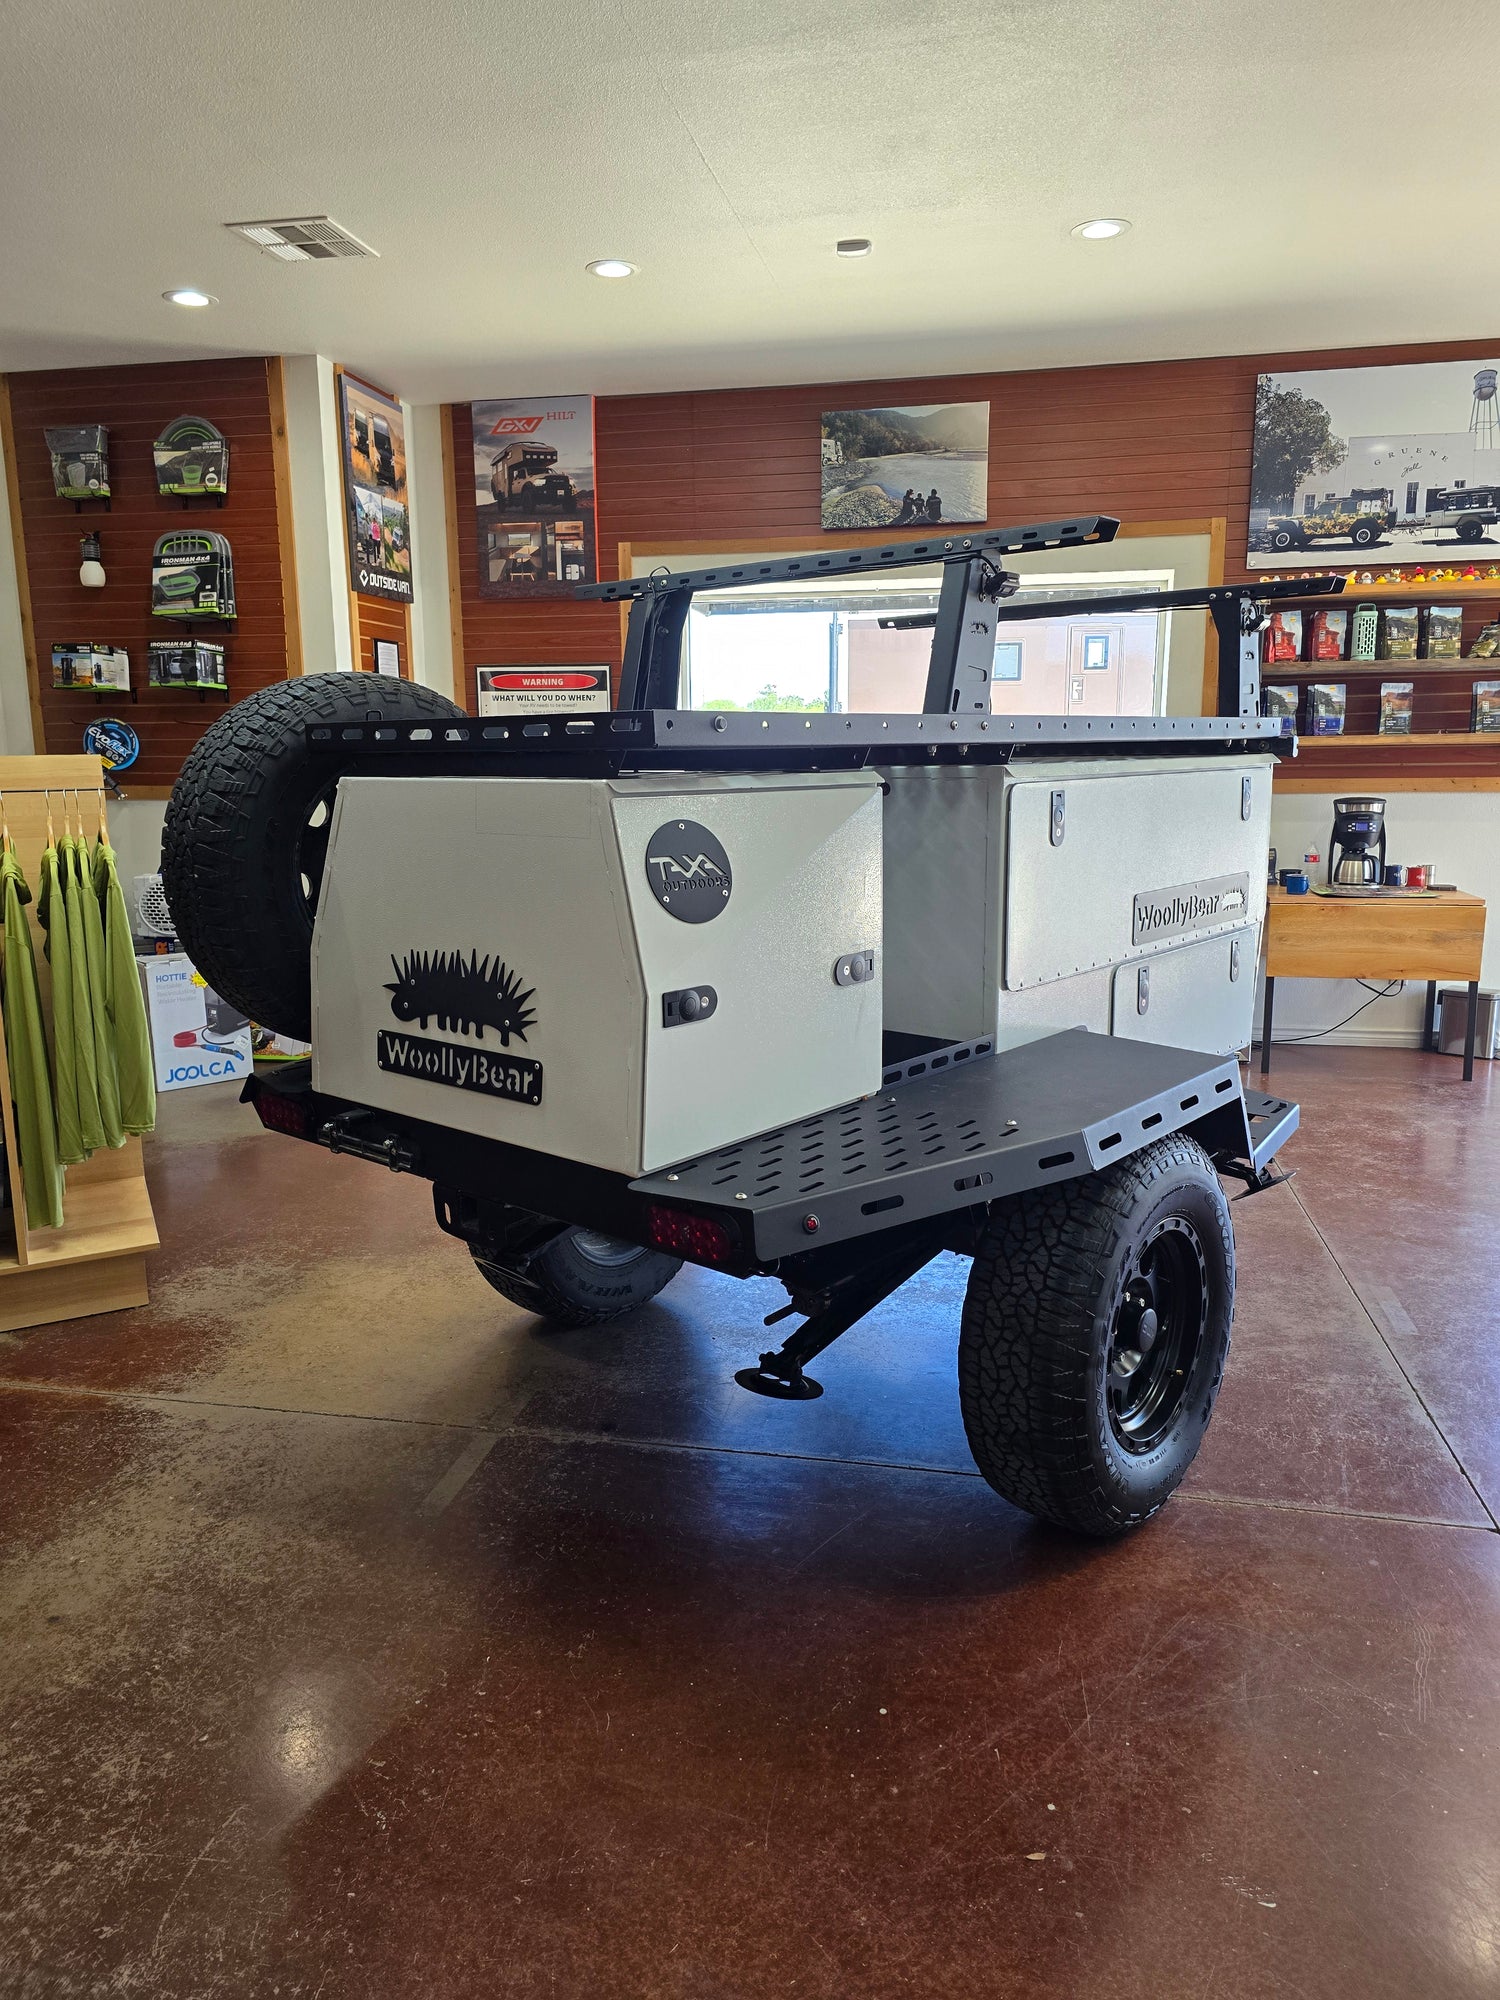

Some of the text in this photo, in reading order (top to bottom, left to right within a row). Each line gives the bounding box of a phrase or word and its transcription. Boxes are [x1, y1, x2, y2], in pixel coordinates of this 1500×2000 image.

[546, 411, 577, 421] HILT
[496, 419, 538, 432] GXV
[1374, 447, 1449, 466] GRUENE
[1401, 462, 1423, 478] Hall
[161, 556, 195, 564] IRONMAN
[369, 573, 411, 594] OUTSIDE VAN
[521, 678, 564, 686] WARNING
[492, 694, 596, 702] WHAT WILL YOU DO WHEN?
[649, 852, 727, 881] TAXA
[663, 875, 731, 892] OUTDOORS
[1137, 894, 1220, 932] WoollyBear
[155, 972, 187, 983] HOTTIE
[165, 1060, 236, 1084] JOOLCA
[385, 1036, 534, 1095] WoollyBear
